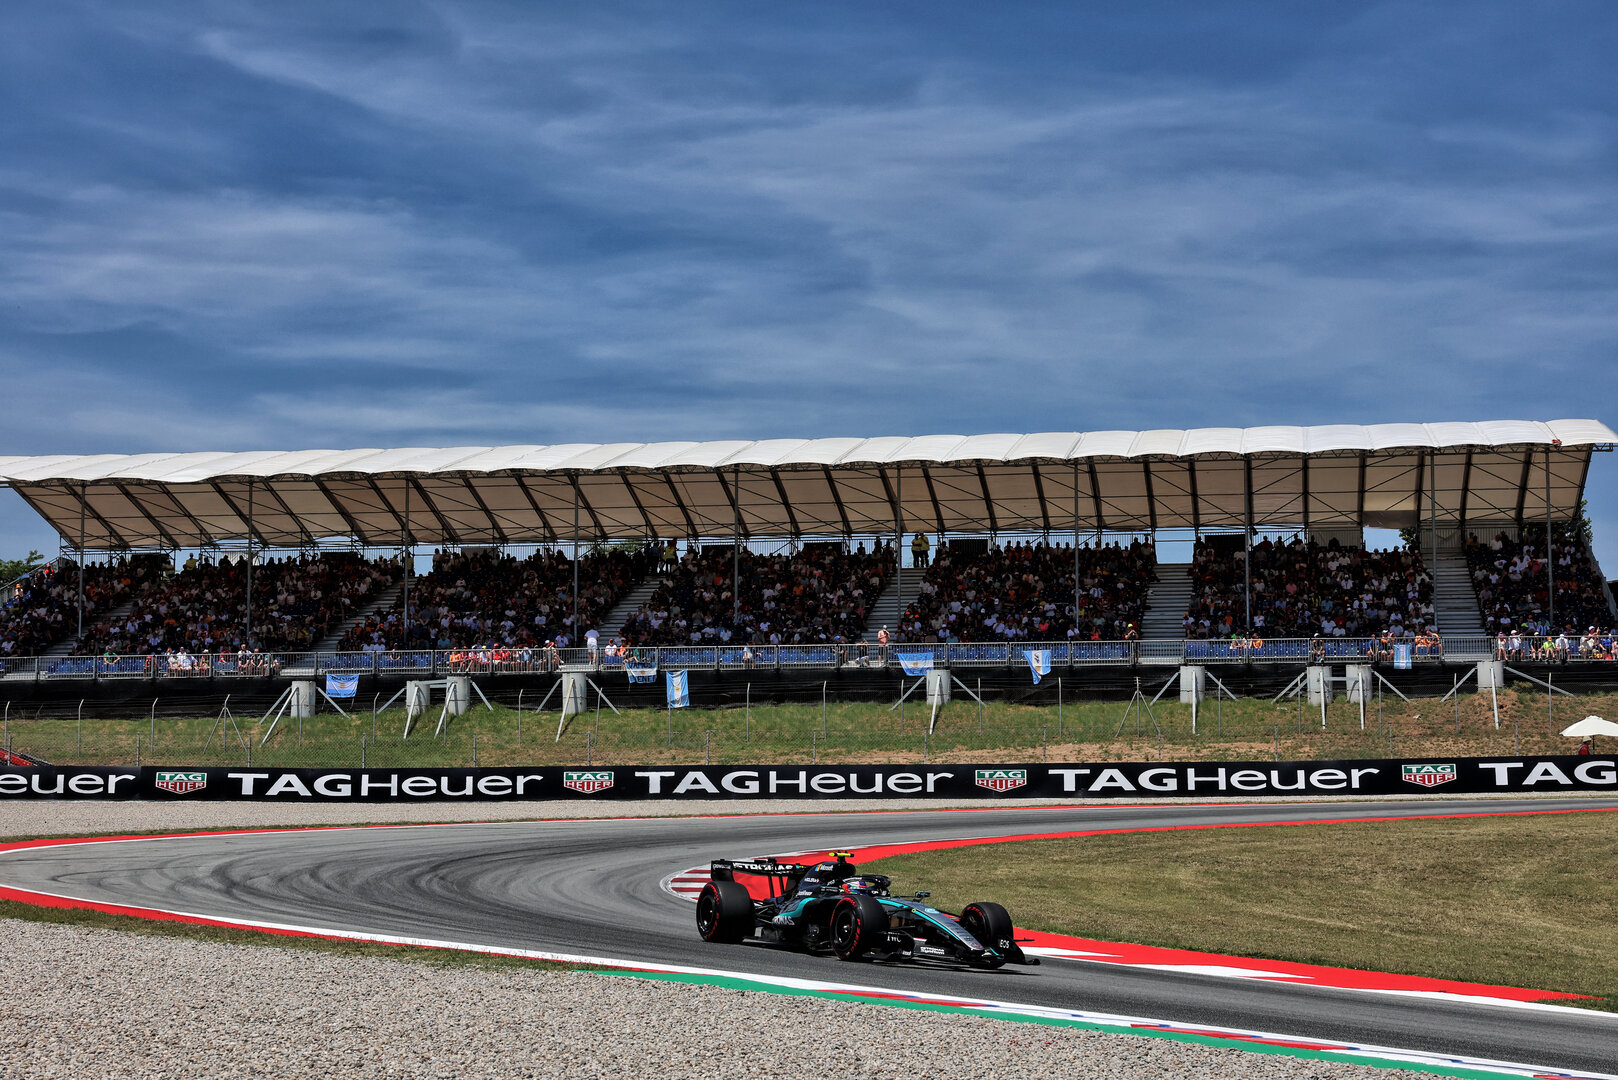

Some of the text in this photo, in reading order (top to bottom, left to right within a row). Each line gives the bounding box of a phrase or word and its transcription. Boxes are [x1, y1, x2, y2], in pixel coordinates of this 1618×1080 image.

[1406, 765, 1451, 773] TAG
[1478, 760, 1617, 786] TAG
[160, 773, 203, 781] TAG
[1405, 774, 1454, 785] HEUER
[158, 781, 204, 792] HEUER
[566, 781, 611, 791] HEUER
[978, 779, 1024, 790] HEUER
